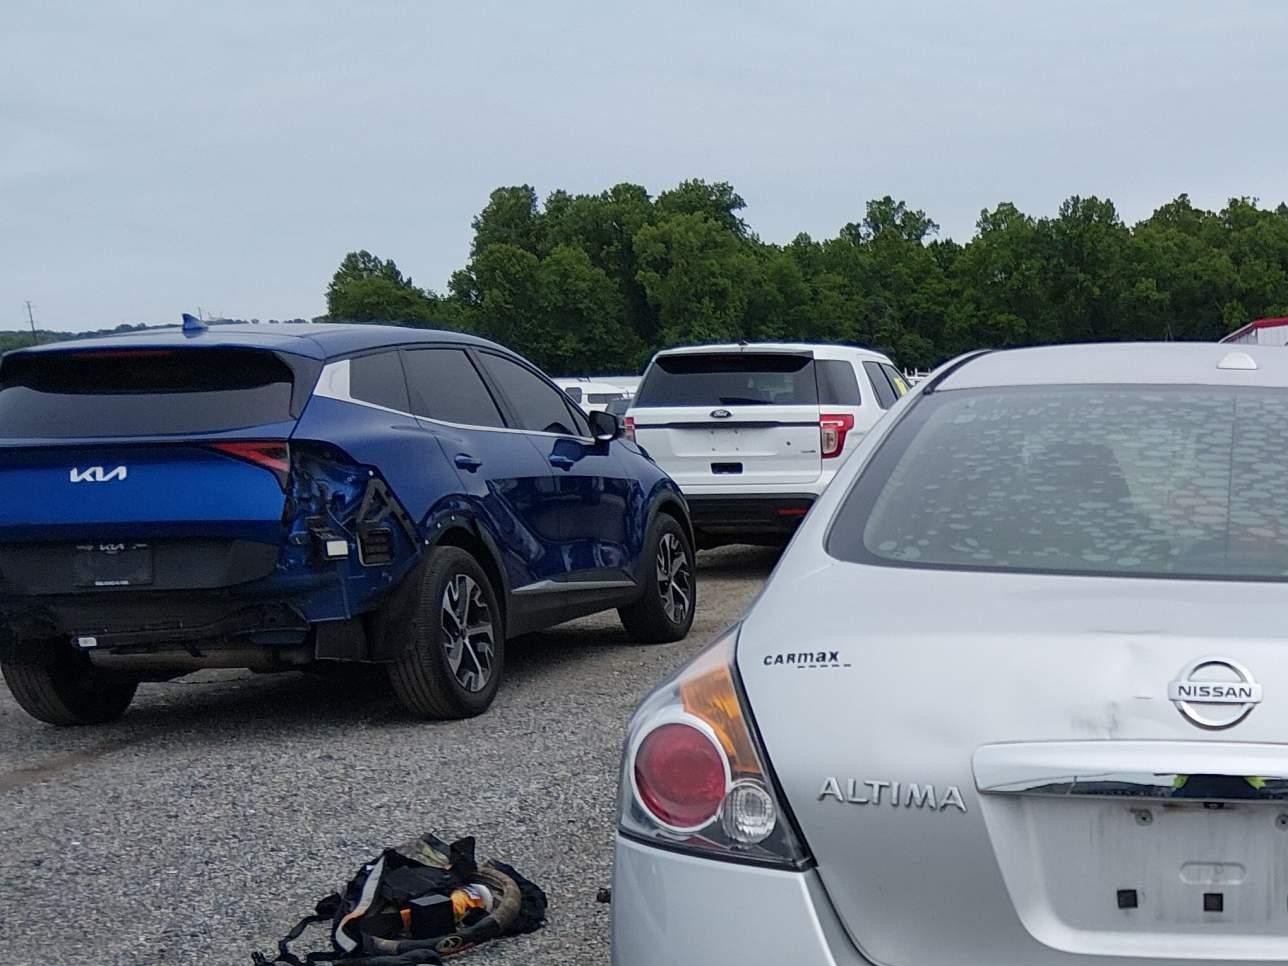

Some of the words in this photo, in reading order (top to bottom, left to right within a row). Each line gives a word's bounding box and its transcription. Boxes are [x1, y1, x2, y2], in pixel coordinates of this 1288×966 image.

[70, 466, 127, 482] KIA
[1178, 685, 1252, 698] NISSAN
[817, 776, 968, 814] ALTIMA
